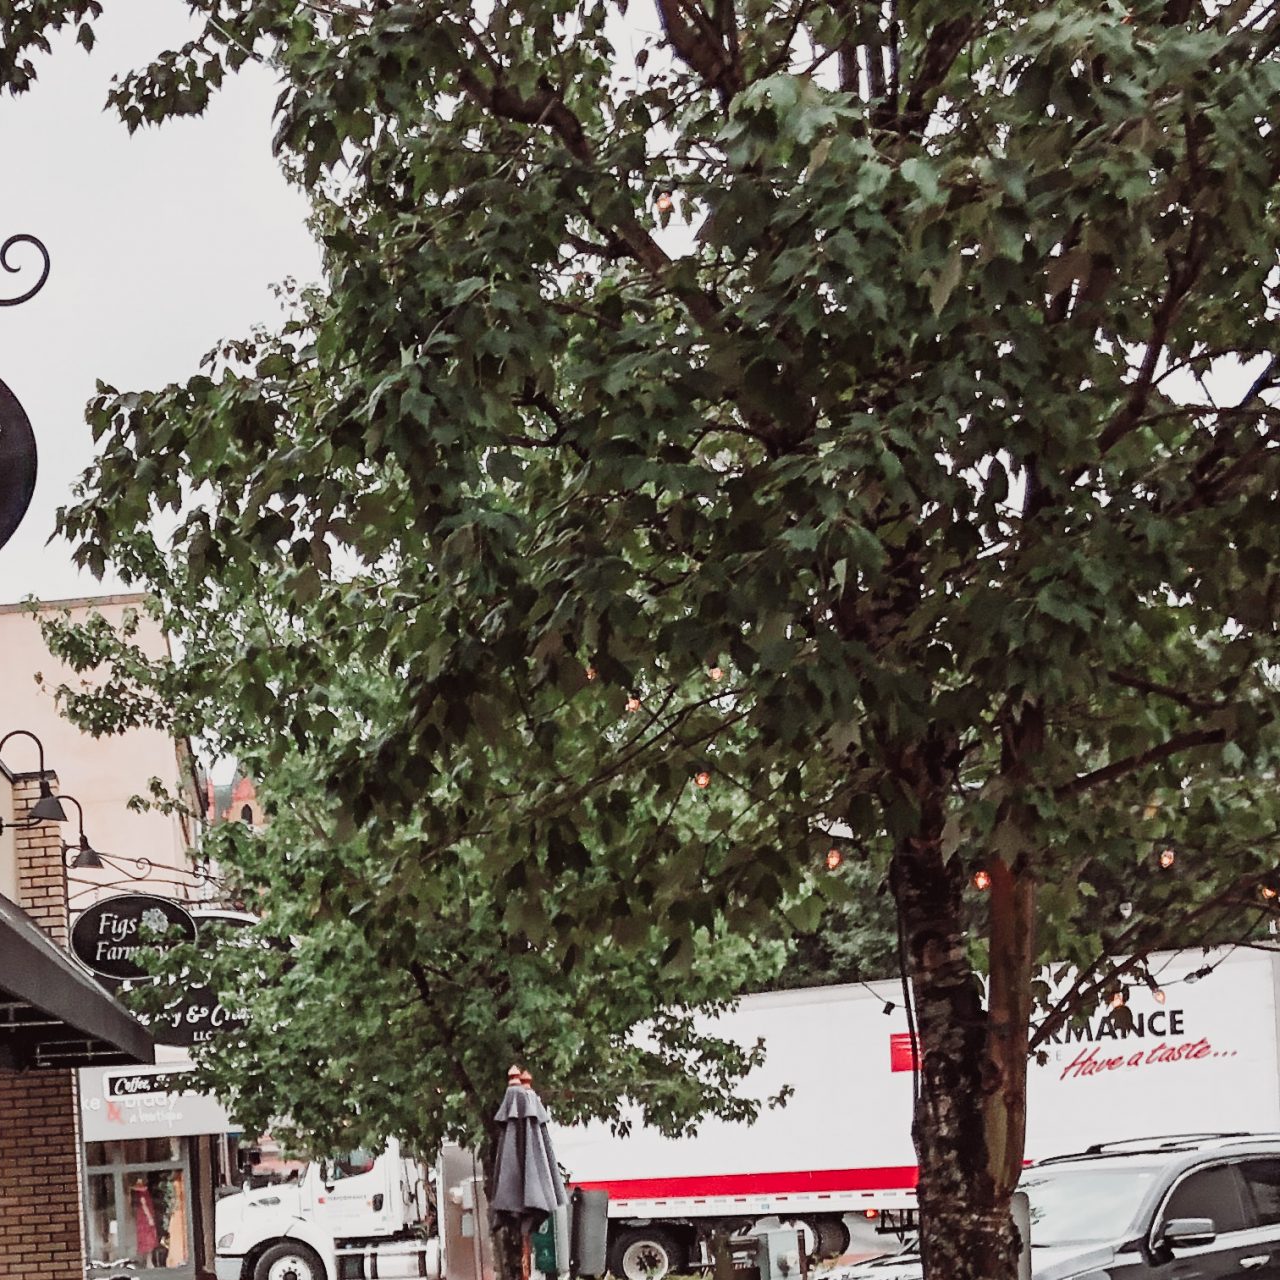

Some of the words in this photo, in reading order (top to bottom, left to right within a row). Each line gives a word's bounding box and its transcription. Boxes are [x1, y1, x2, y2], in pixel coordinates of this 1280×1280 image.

[99, 913, 137, 942] Figs
[1059, 1046, 1124, 1081] Have
[1127, 1051, 1140, 1067] a
